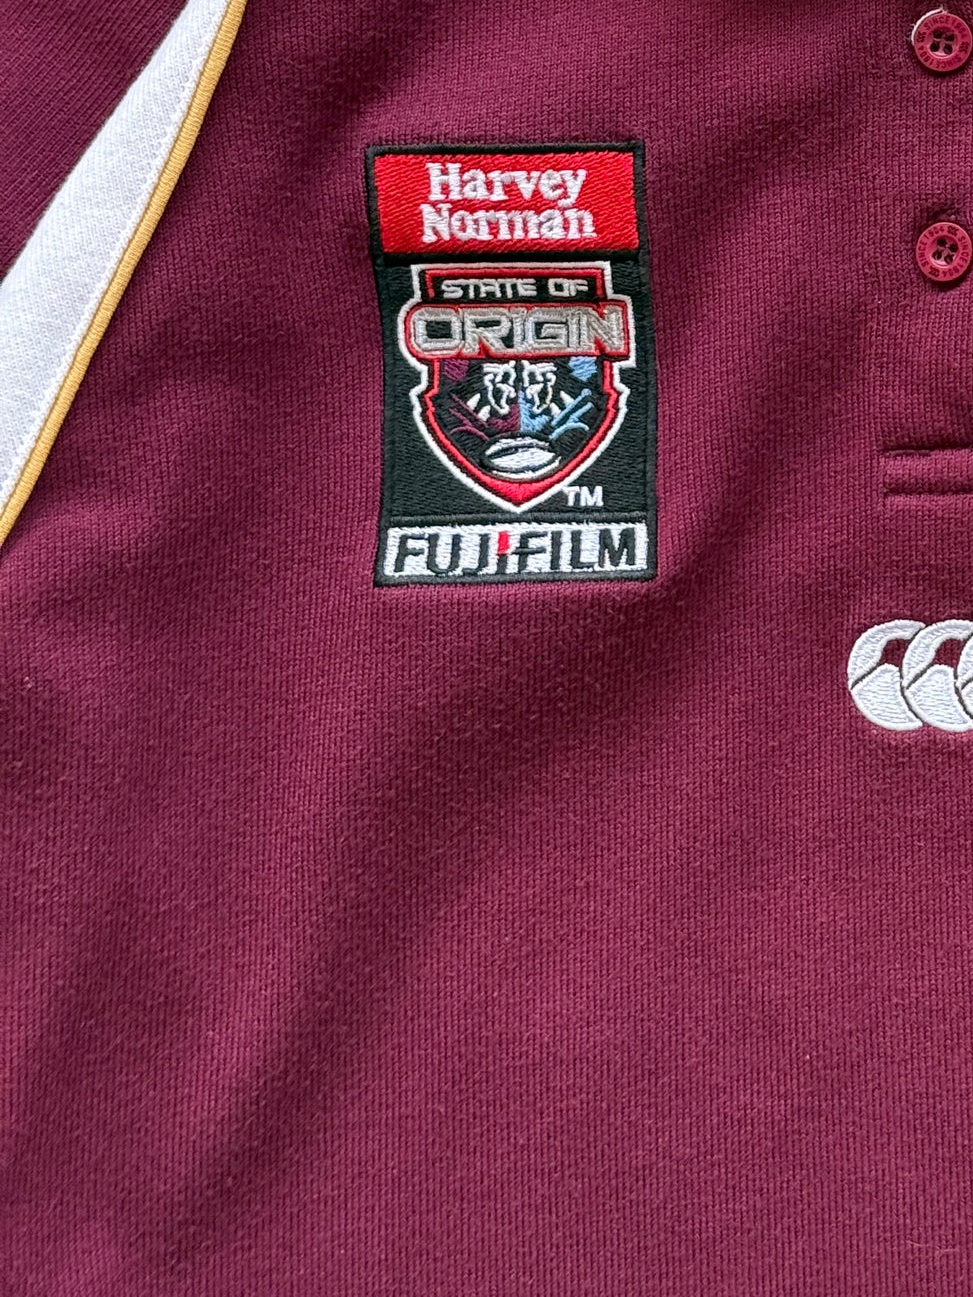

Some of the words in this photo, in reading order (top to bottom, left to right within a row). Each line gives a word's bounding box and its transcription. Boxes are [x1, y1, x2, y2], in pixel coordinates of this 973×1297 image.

[425, 162, 588, 209] Harvey
[420, 203, 597, 242] Norman
[441, 278, 538, 299] STATE
[547, 278, 590, 298] OF
[409, 305, 626, 356] ORIGIN
[564, 485, 603, 508] TM
[394, 529, 638, 575] FUJIFILM
